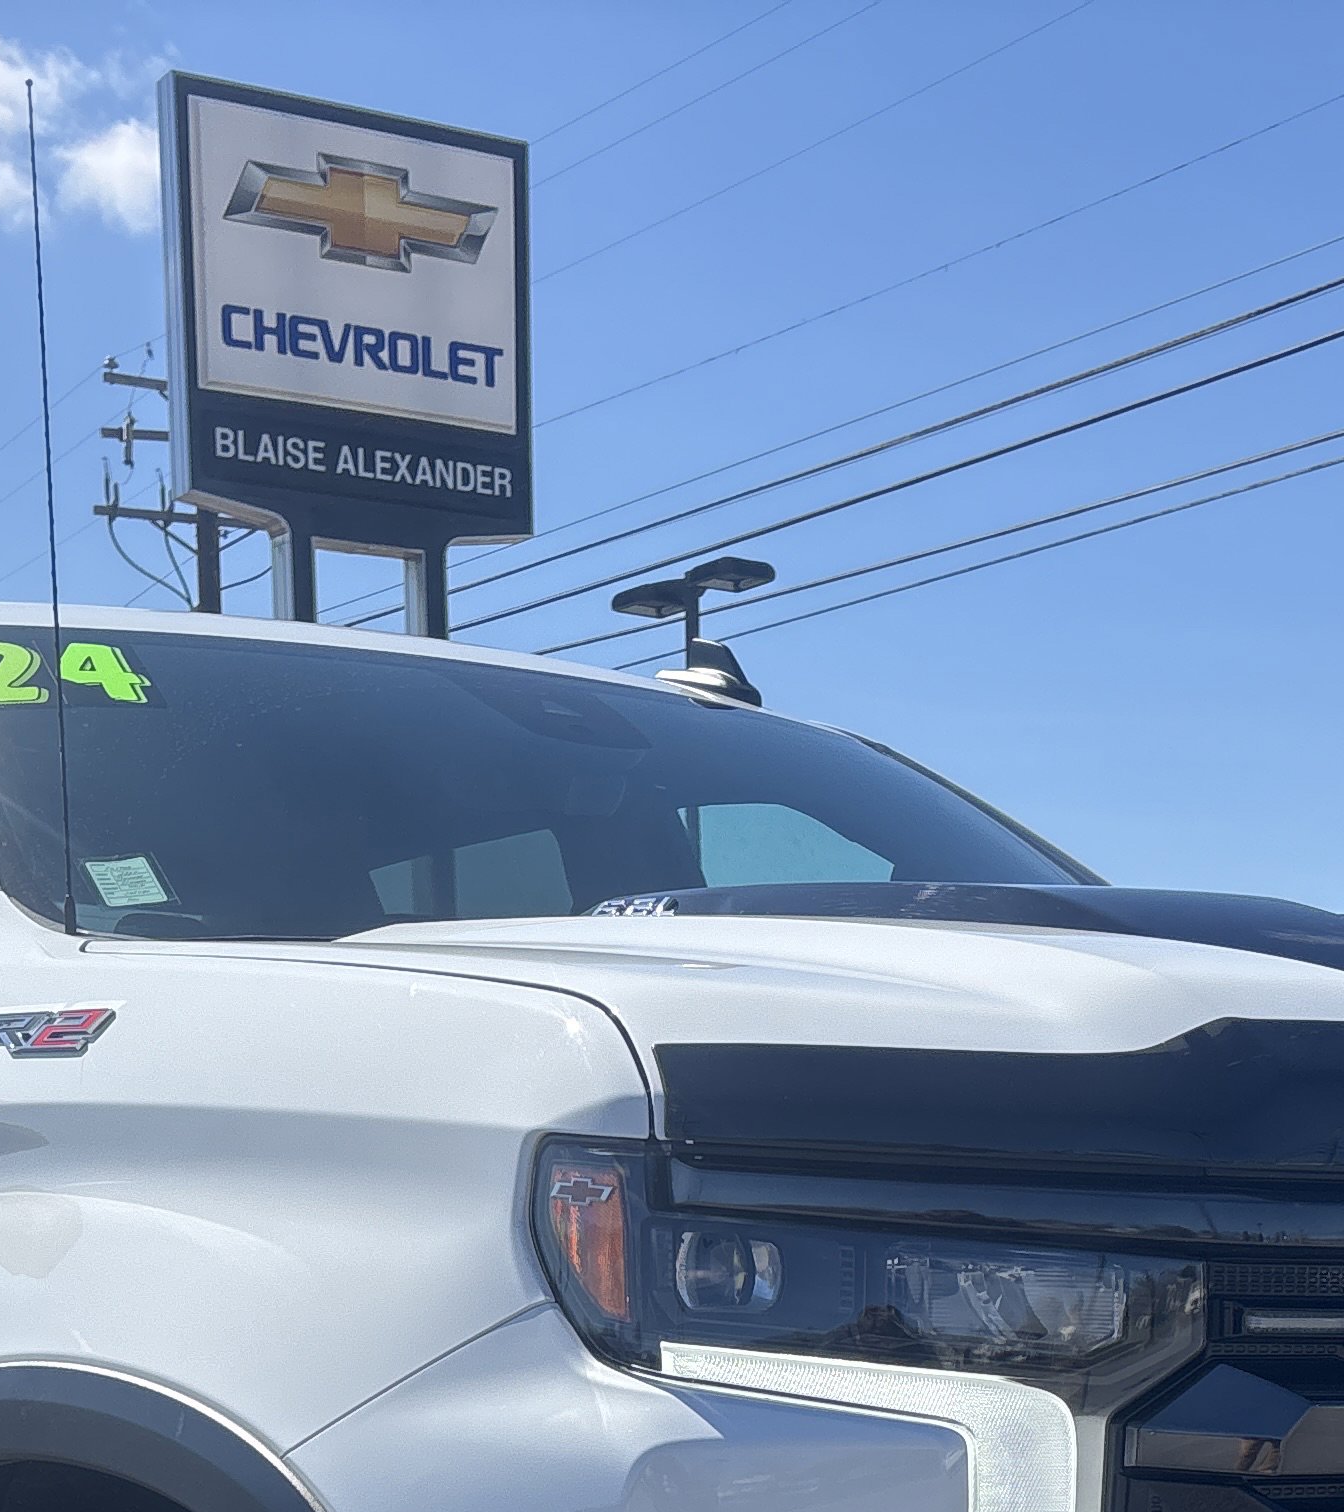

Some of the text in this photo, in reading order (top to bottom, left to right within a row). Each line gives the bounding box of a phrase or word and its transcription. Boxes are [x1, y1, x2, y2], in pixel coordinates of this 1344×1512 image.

[221, 304, 504, 388] CHEVROLET
[215, 427, 513, 498] BLAISE ALEXANDER
